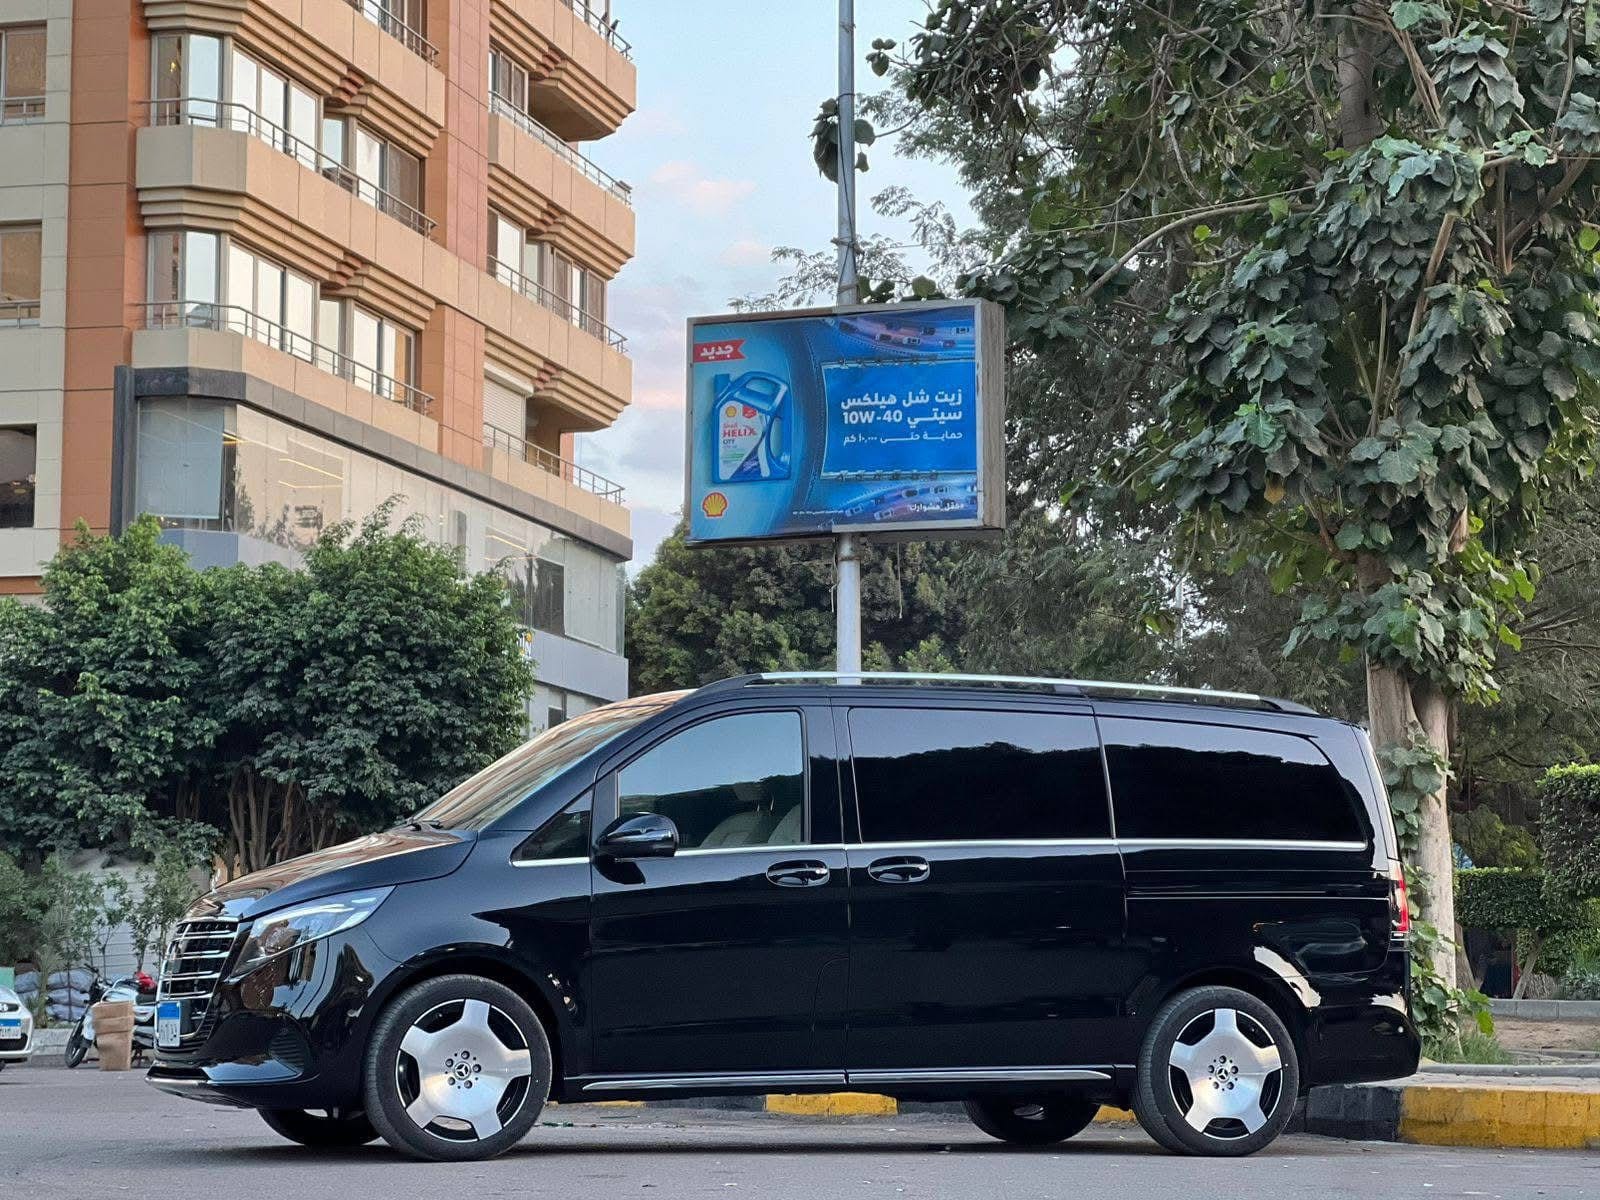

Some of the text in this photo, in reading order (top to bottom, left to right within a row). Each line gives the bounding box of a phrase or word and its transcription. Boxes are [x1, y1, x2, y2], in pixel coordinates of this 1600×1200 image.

[700, 344, 734, 360] جديد
[841, 388, 963, 409] زيت شل هيلكس
[722, 428, 757, 438] HELIX
